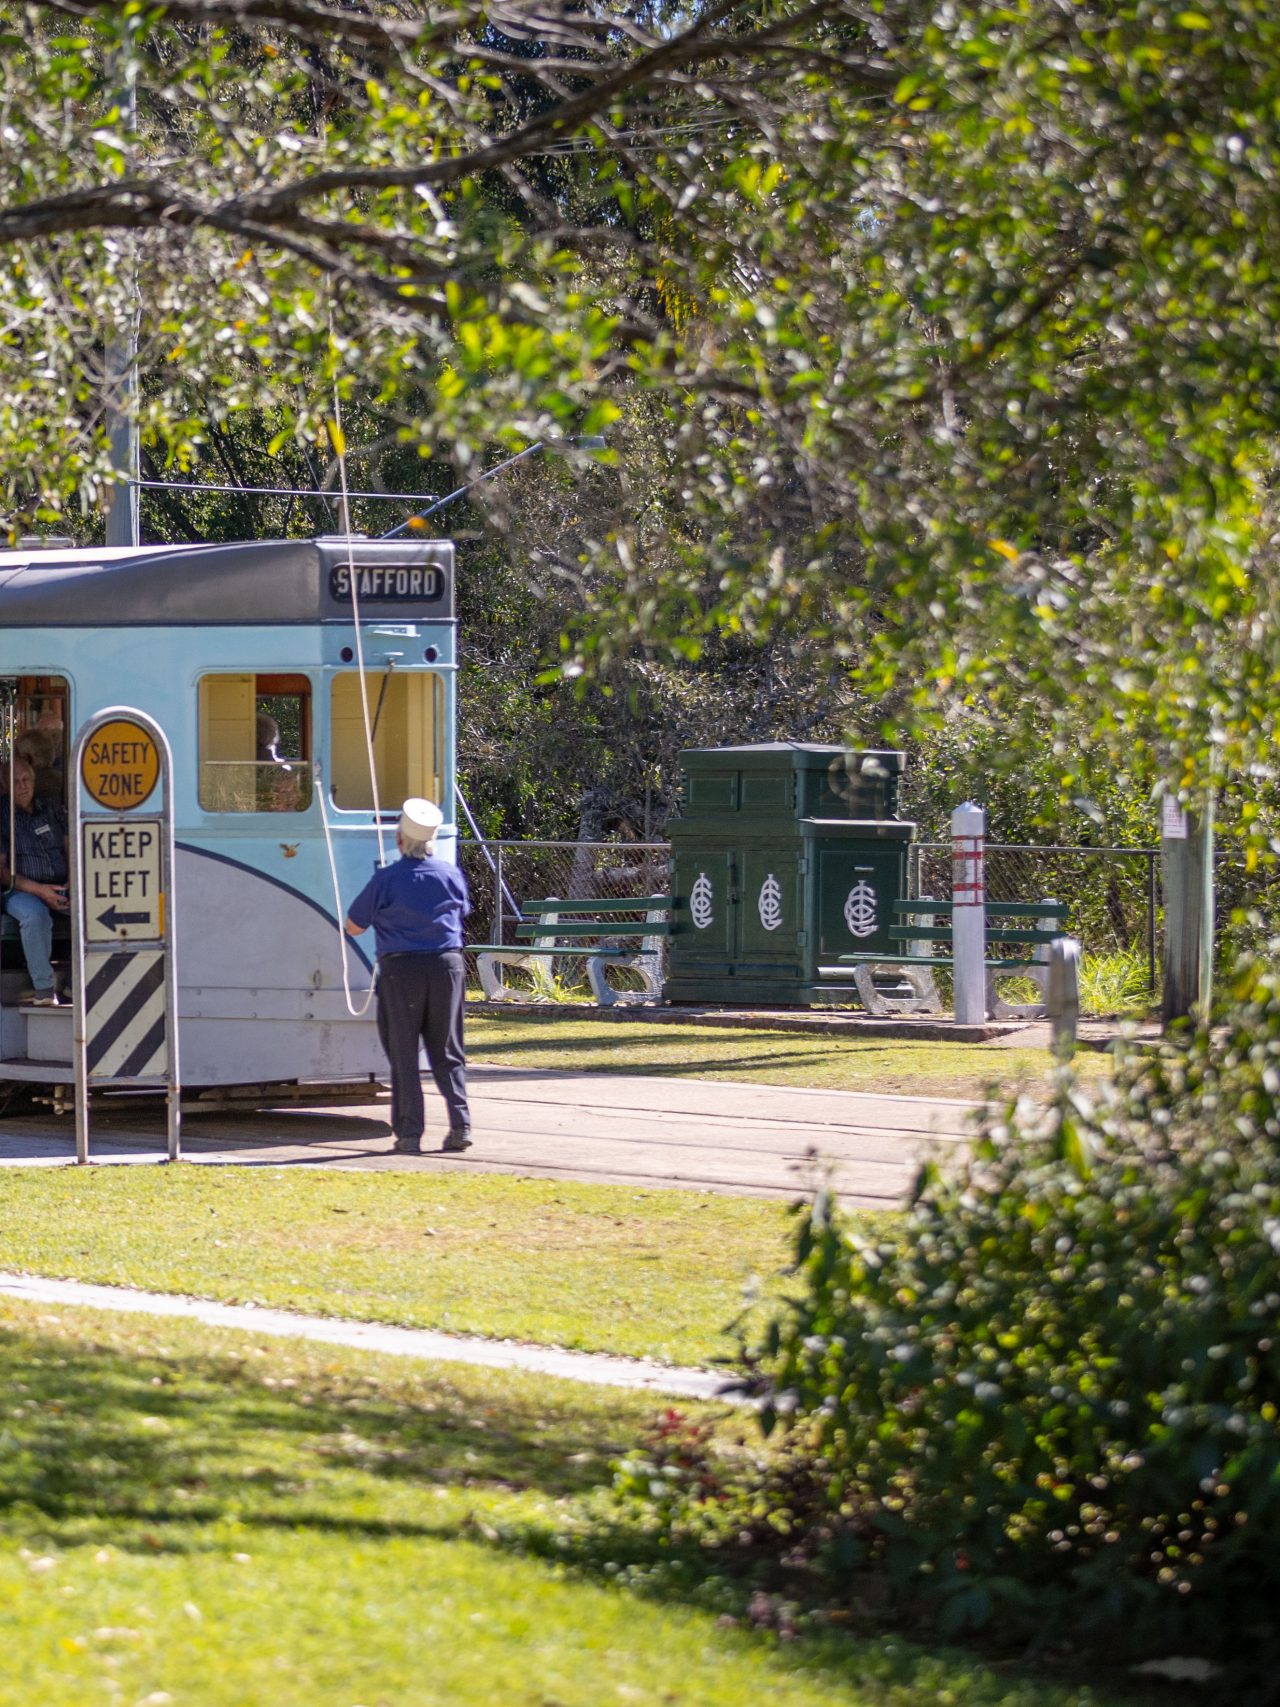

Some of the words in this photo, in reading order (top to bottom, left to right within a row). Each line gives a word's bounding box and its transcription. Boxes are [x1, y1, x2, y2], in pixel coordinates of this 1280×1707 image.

[90, 743, 150, 765] SAFETY
[98, 774, 144, 796] ZONE
[91, 831, 152, 858] KEEP
[94, 871, 150, 897] LEFT
